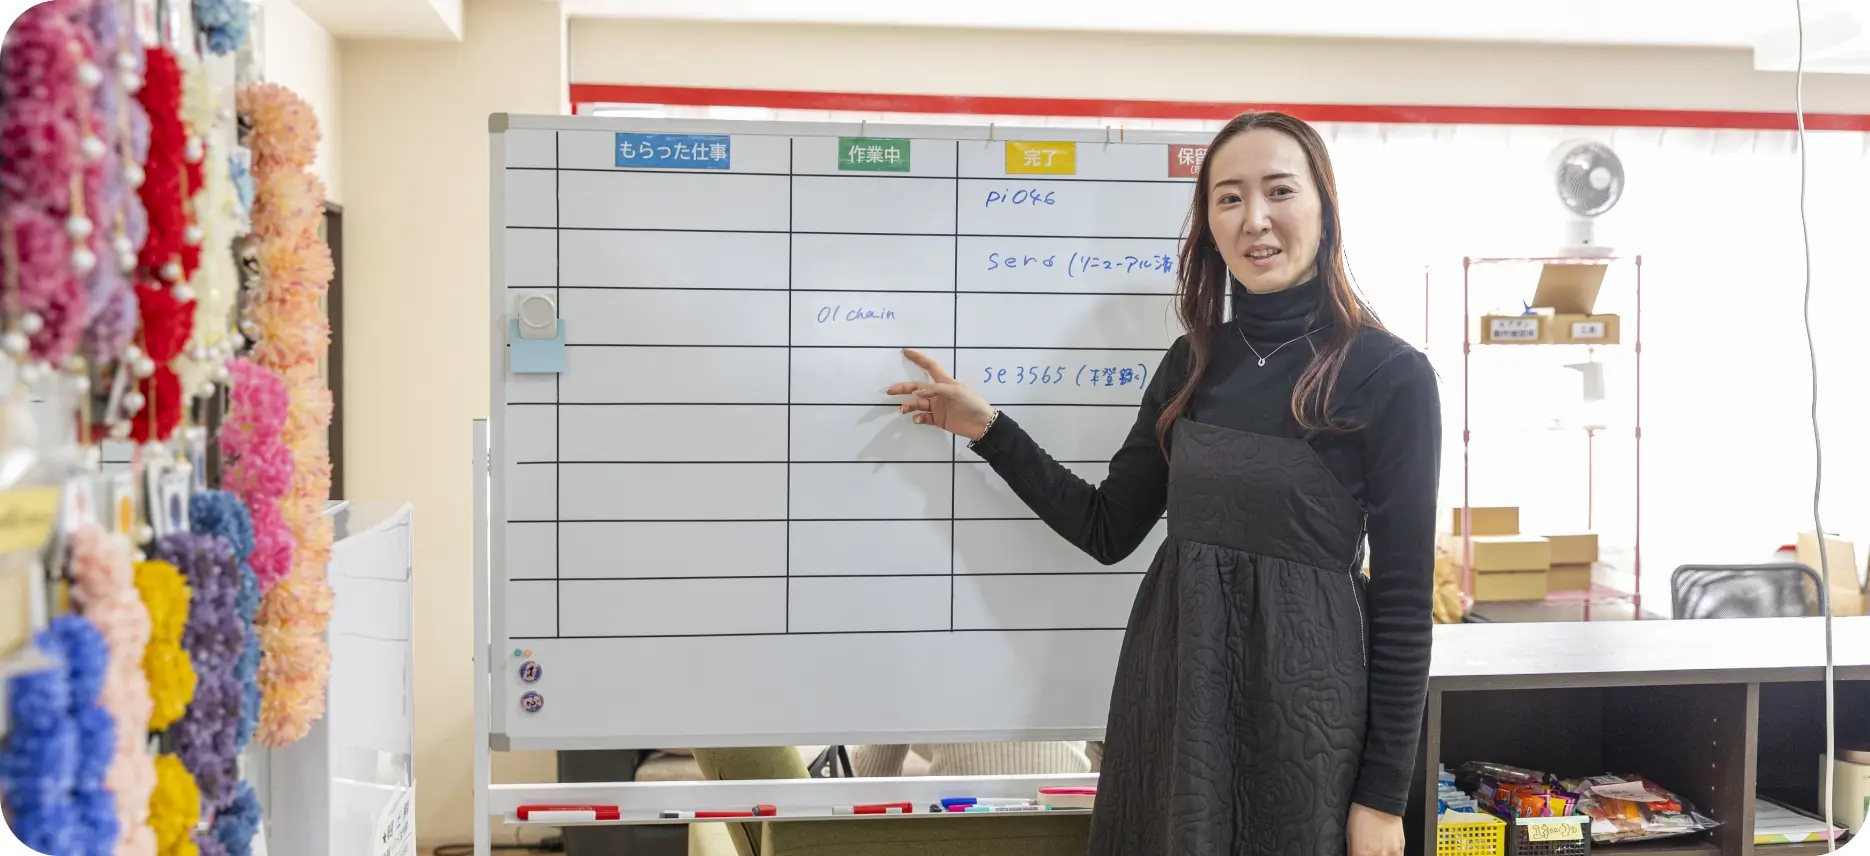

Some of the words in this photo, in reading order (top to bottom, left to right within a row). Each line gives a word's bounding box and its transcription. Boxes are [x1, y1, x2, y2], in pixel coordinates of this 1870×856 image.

[619, 140, 728, 162] もらった仕事
[848, 145, 901, 165] 作業中
[1023, 149, 1057, 168] 完了
[1178, 147, 1208, 166] 保留
[845, 307, 896, 322] chain
